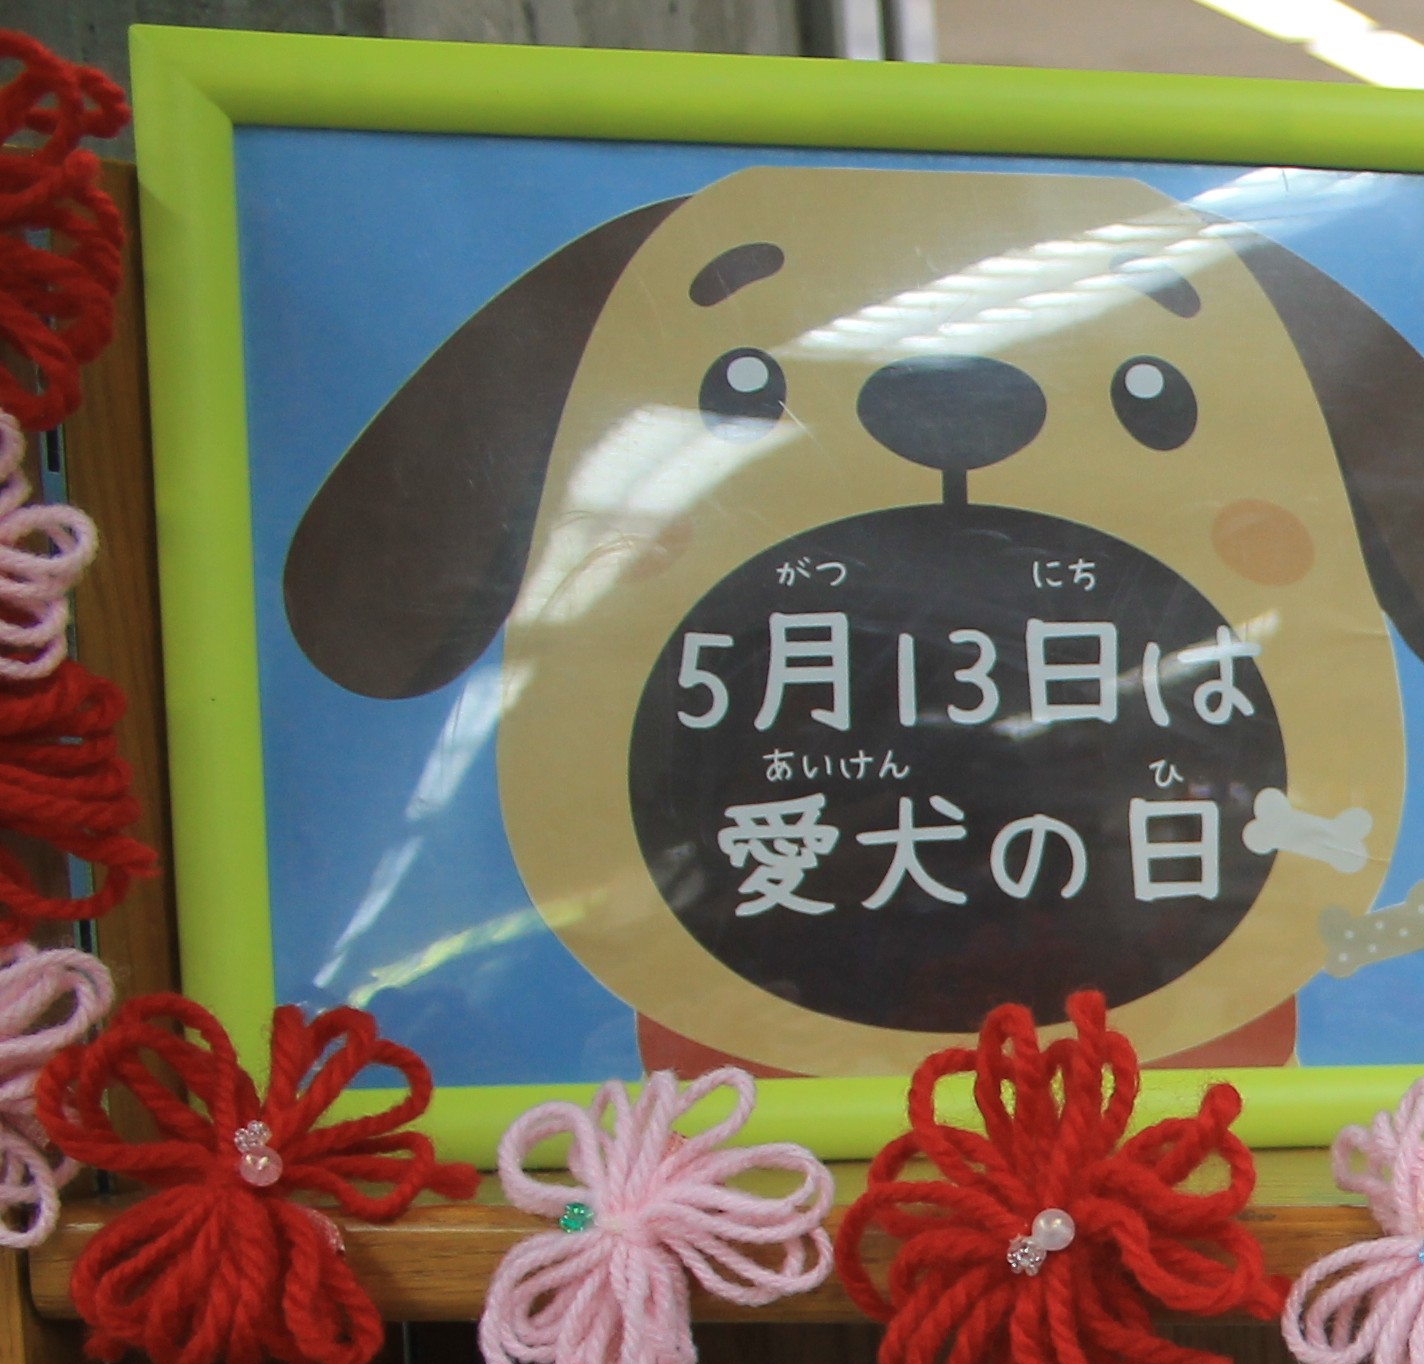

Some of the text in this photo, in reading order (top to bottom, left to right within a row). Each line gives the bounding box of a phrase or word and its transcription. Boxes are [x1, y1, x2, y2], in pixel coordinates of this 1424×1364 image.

[776, 556, 848, 588] がつ
[1032, 557, 1098, 591] にち
[676, 610, 1263, 731] 5月13日は
[762, 748, 911, 781] あいけん
[1148, 759, 1186, 788] ひ
[716, 792, 1220, 917] 愛犬の日
